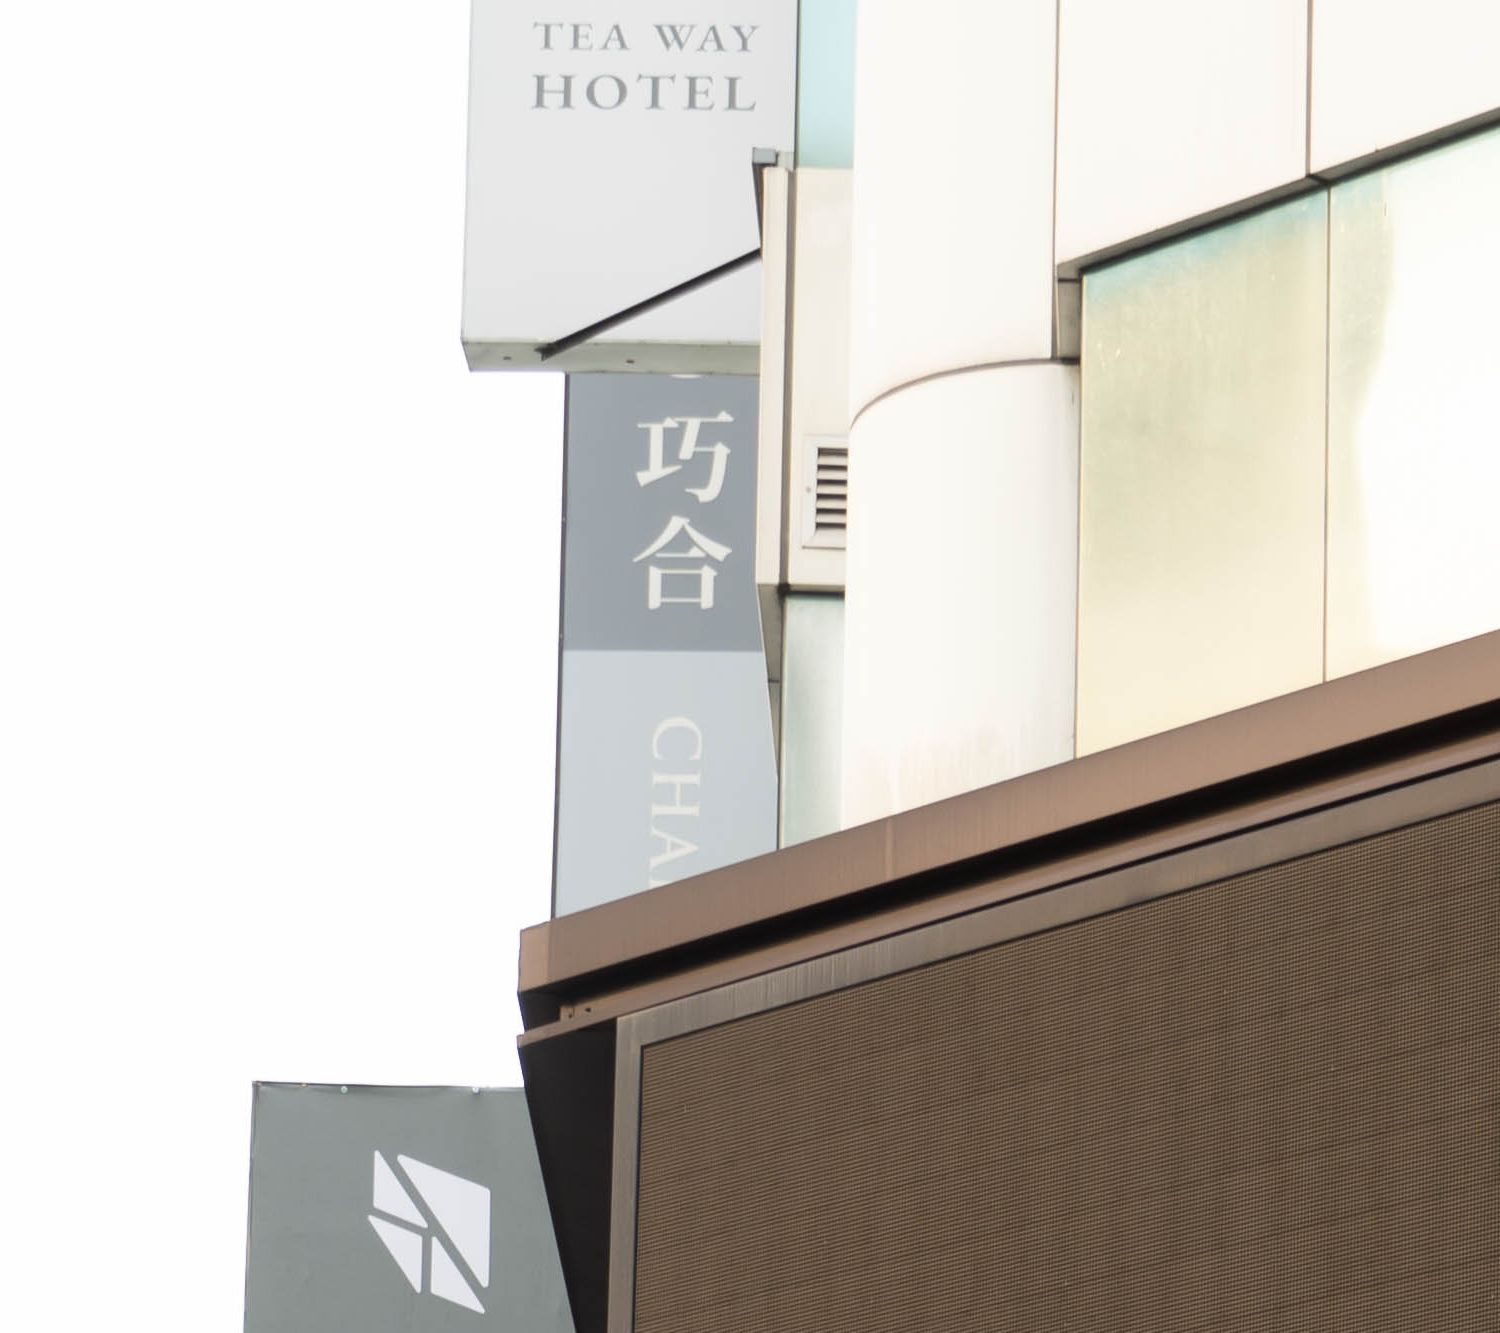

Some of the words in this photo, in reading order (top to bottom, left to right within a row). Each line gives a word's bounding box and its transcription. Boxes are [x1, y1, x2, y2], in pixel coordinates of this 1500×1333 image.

[532, 21, 631, 51] TEA
[653, 23, 760, 52] WAY
[532, 73, 757, 112] HOTEL
[632, 410, 735, 611] 巧合
[649, 715, 703, 890] CHA
